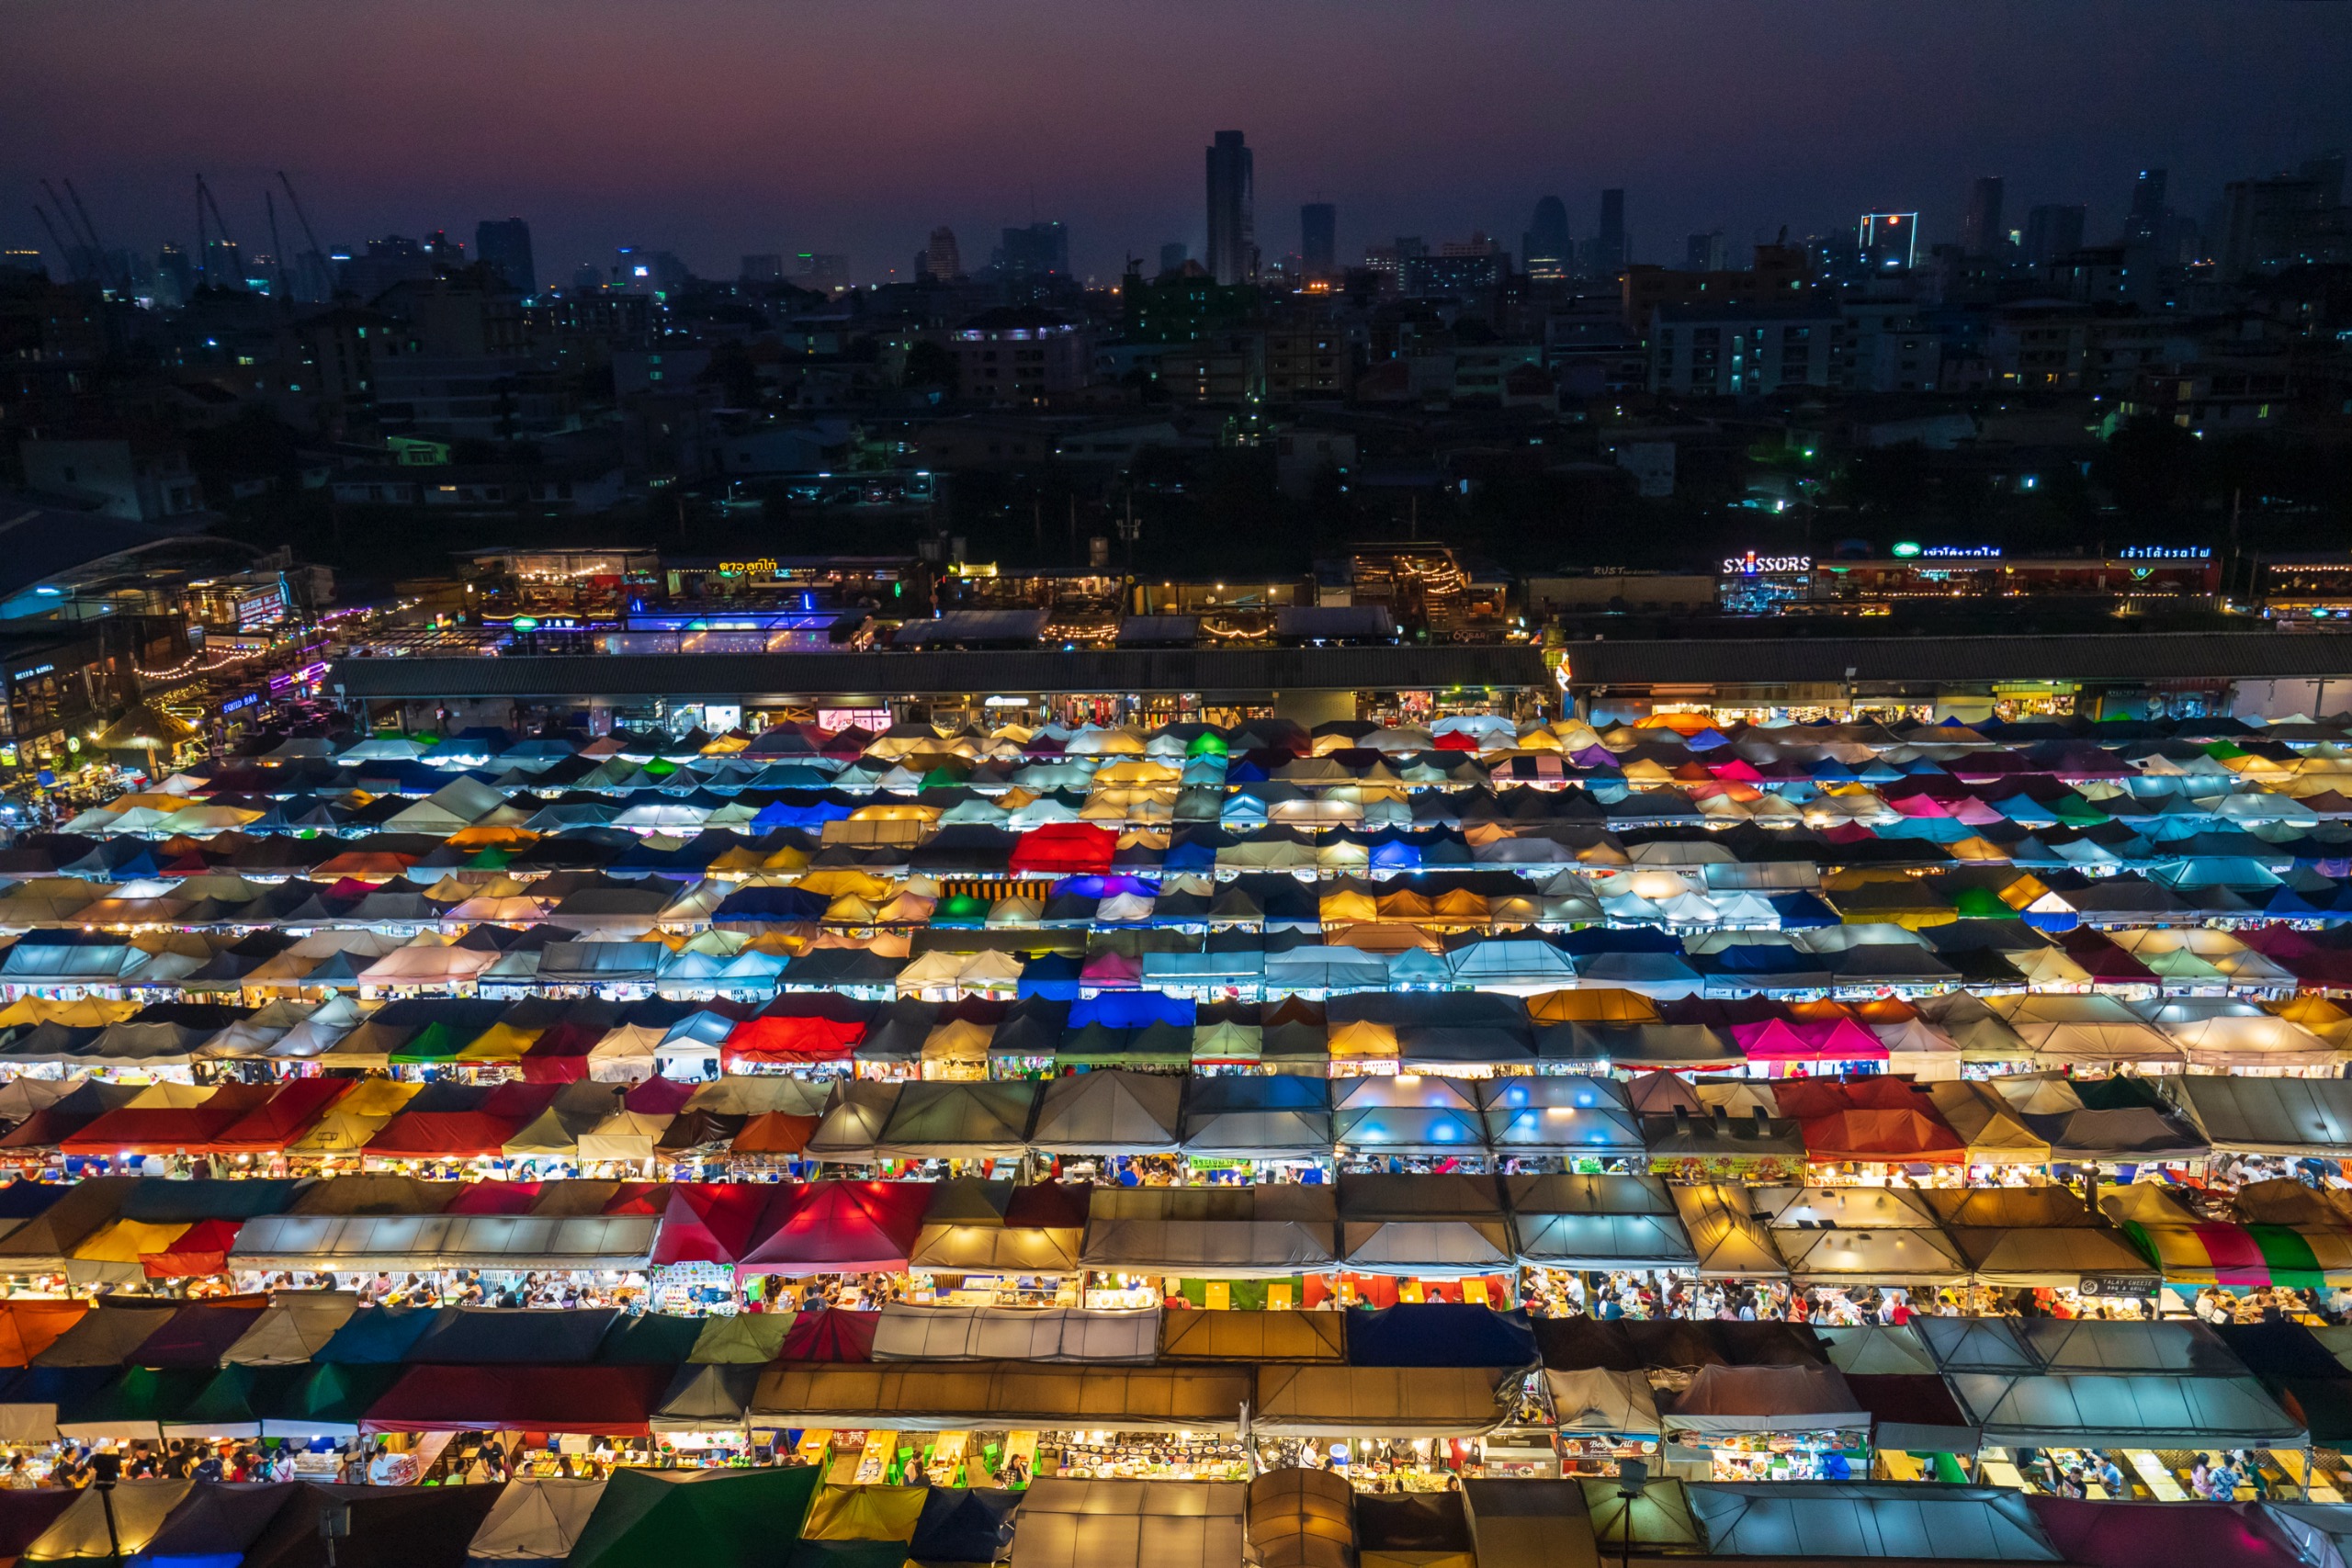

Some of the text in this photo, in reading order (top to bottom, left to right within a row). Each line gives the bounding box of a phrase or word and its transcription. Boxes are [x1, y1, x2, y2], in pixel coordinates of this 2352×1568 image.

[1594, 566, 1625, 575] RUST
[223, 693, 258, 713] SQUID BAR
